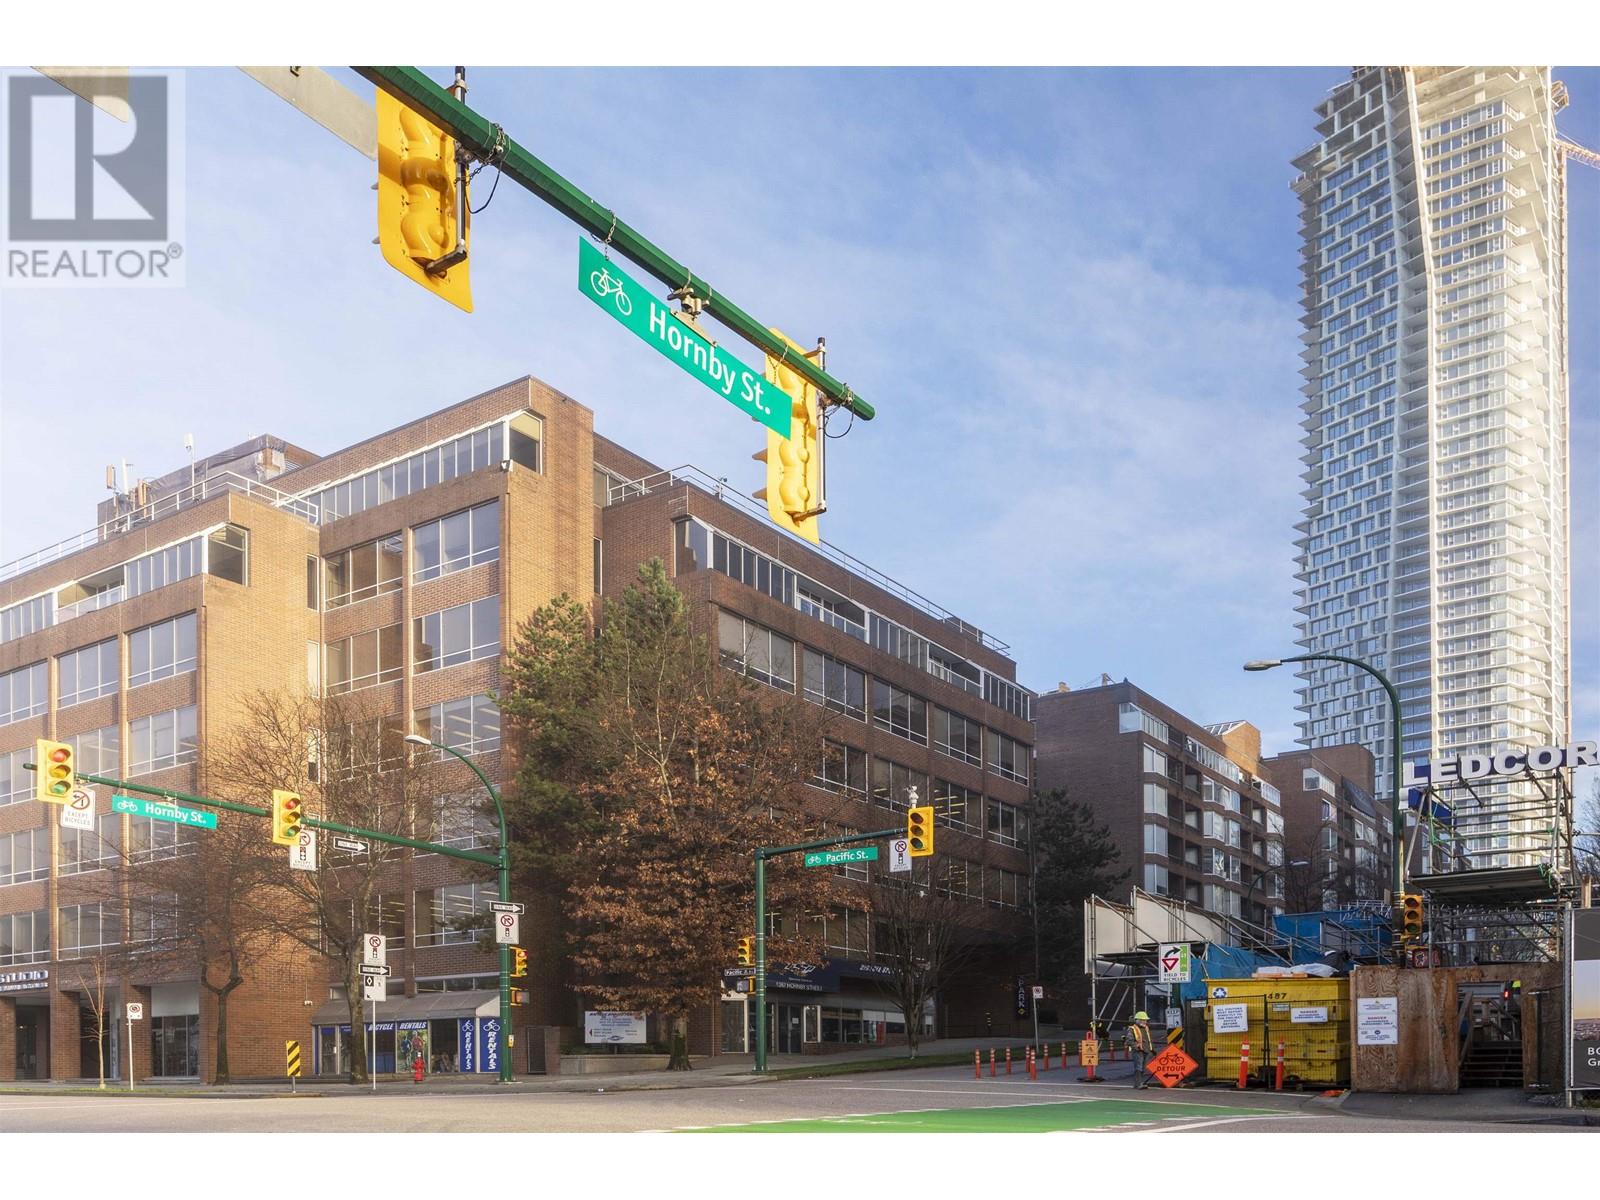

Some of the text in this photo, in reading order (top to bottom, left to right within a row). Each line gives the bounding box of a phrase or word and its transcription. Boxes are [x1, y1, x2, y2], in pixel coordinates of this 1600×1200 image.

[649, 301, 771, 415] Hornby St.
[1402, 741, 1600, 786] LEDCOR
[145, 803, 207, 824] Hornby St.
[826, 850, 869, 863] Pacific St.
[1267, 992, 1288, 1000] 487
[368, 1023, 393, 1032] BCYCLE
[400, 1021, 427, 1030] RENTALS
[464, 1032, 472, 1070] RENTALS
[488, 1031, 497, 1070] RENTALS
